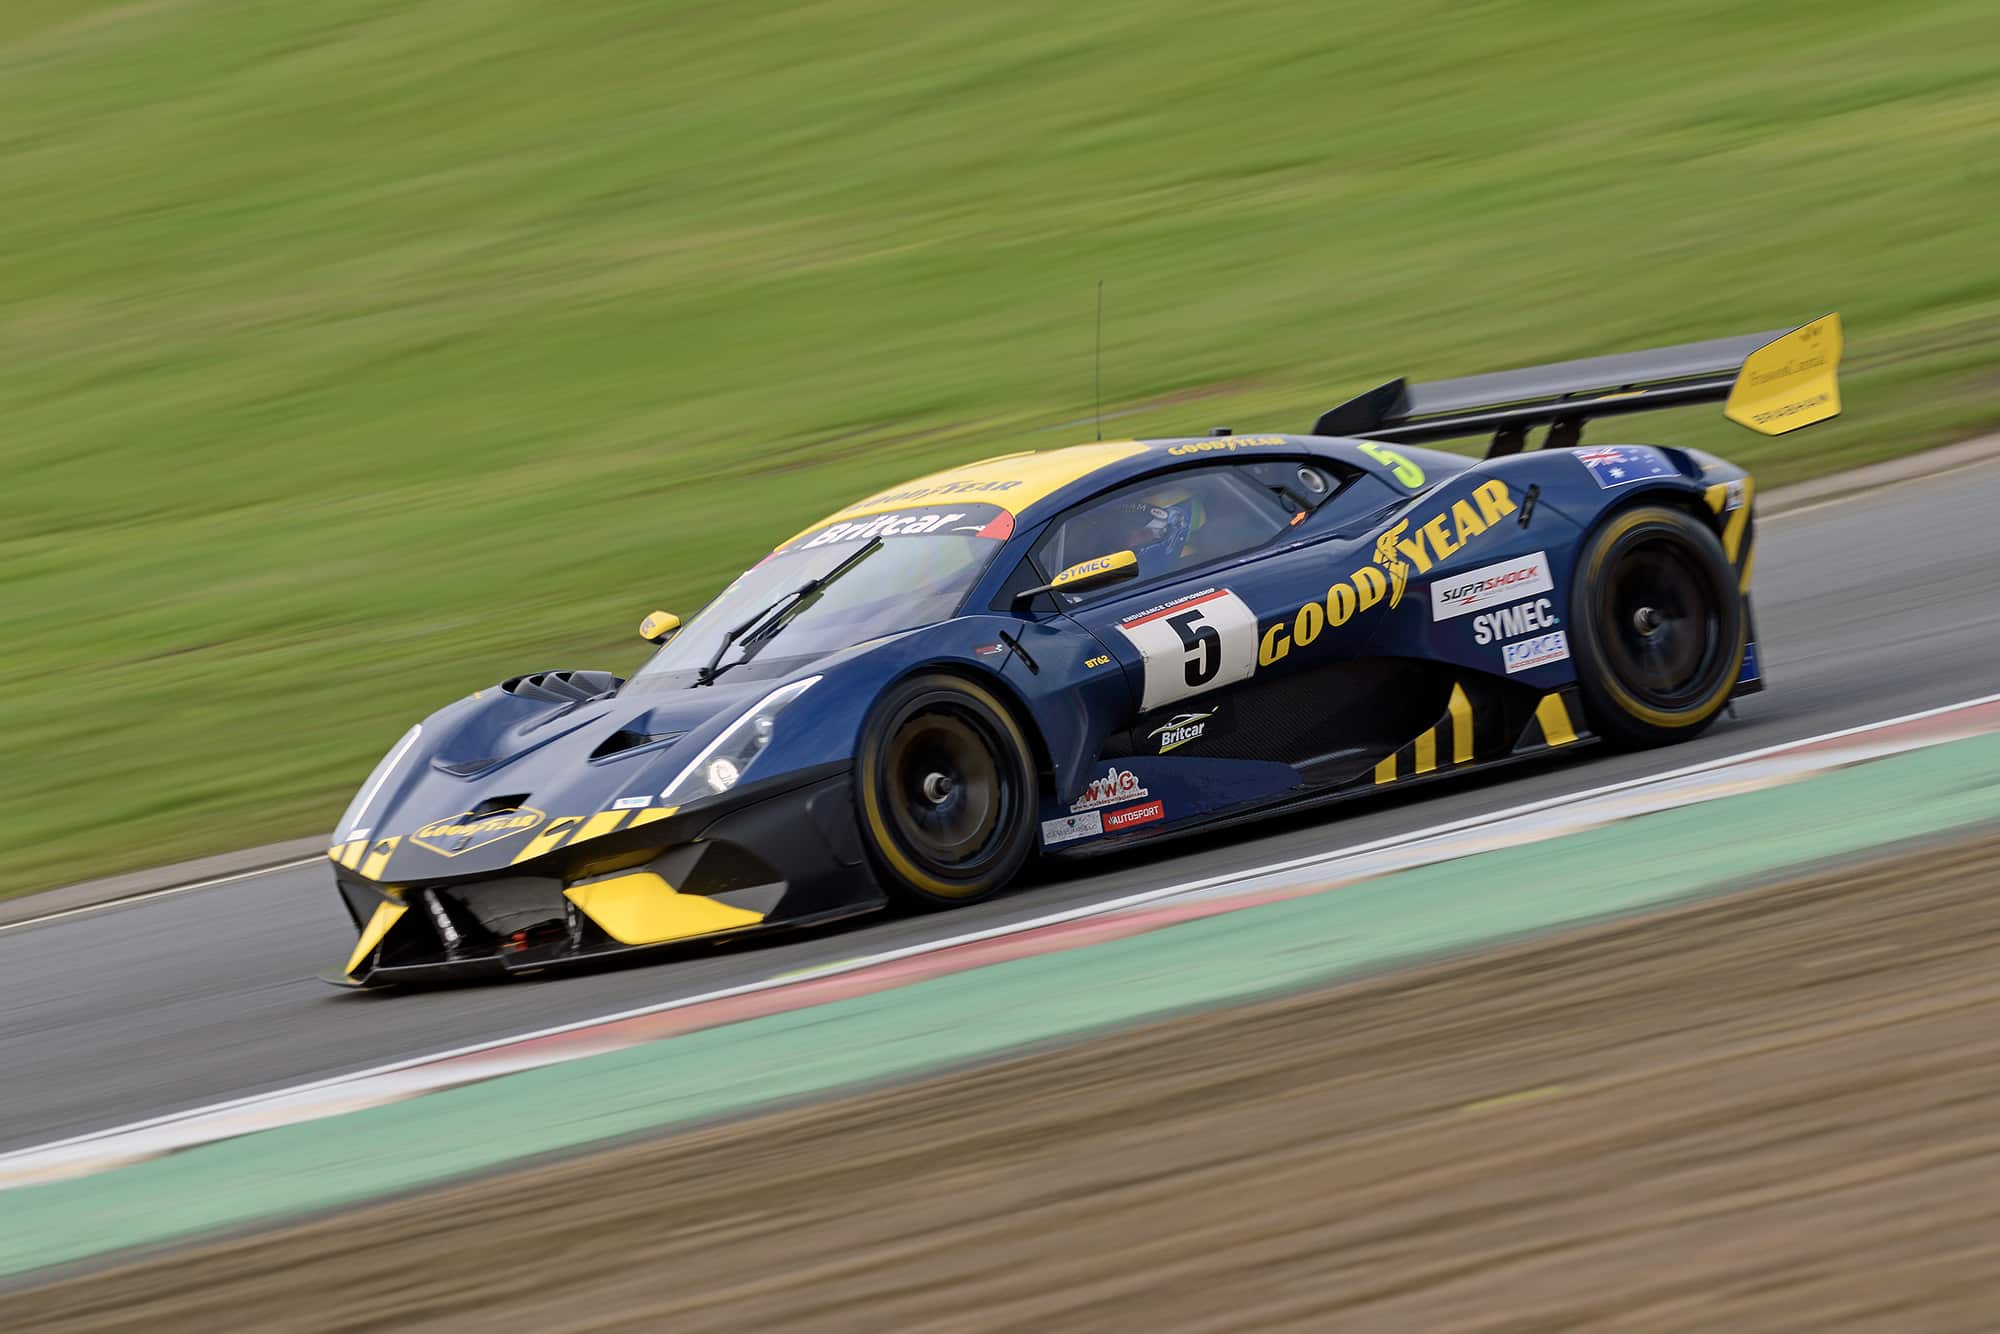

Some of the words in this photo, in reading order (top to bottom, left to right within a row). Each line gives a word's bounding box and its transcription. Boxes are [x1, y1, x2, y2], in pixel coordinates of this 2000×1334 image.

[1168, 437, 1288, 456] GOODYEAR
[1357, 442, 1425, 488] 5
[802, 513, 966, 550] Britcar
[1058, 557, 1112, 581] SYMEC
[1259, 479, 1518, 667] GOODYEAR
[1440, 565, 1537, 602] SUPASHOCK
[1122, 604, 1166, 622] ENDURANCE
[1084, 655, 1110, 669] BT62
[1166, 609, 1221, 687] 5
[1507, 634, 1563, 662] FORCE
[1161, 722, 1205, 746] Britcar
[1083, 772, 1135, 802] WWG
[1112, 805, 1159, 825] AUTOSPORT
